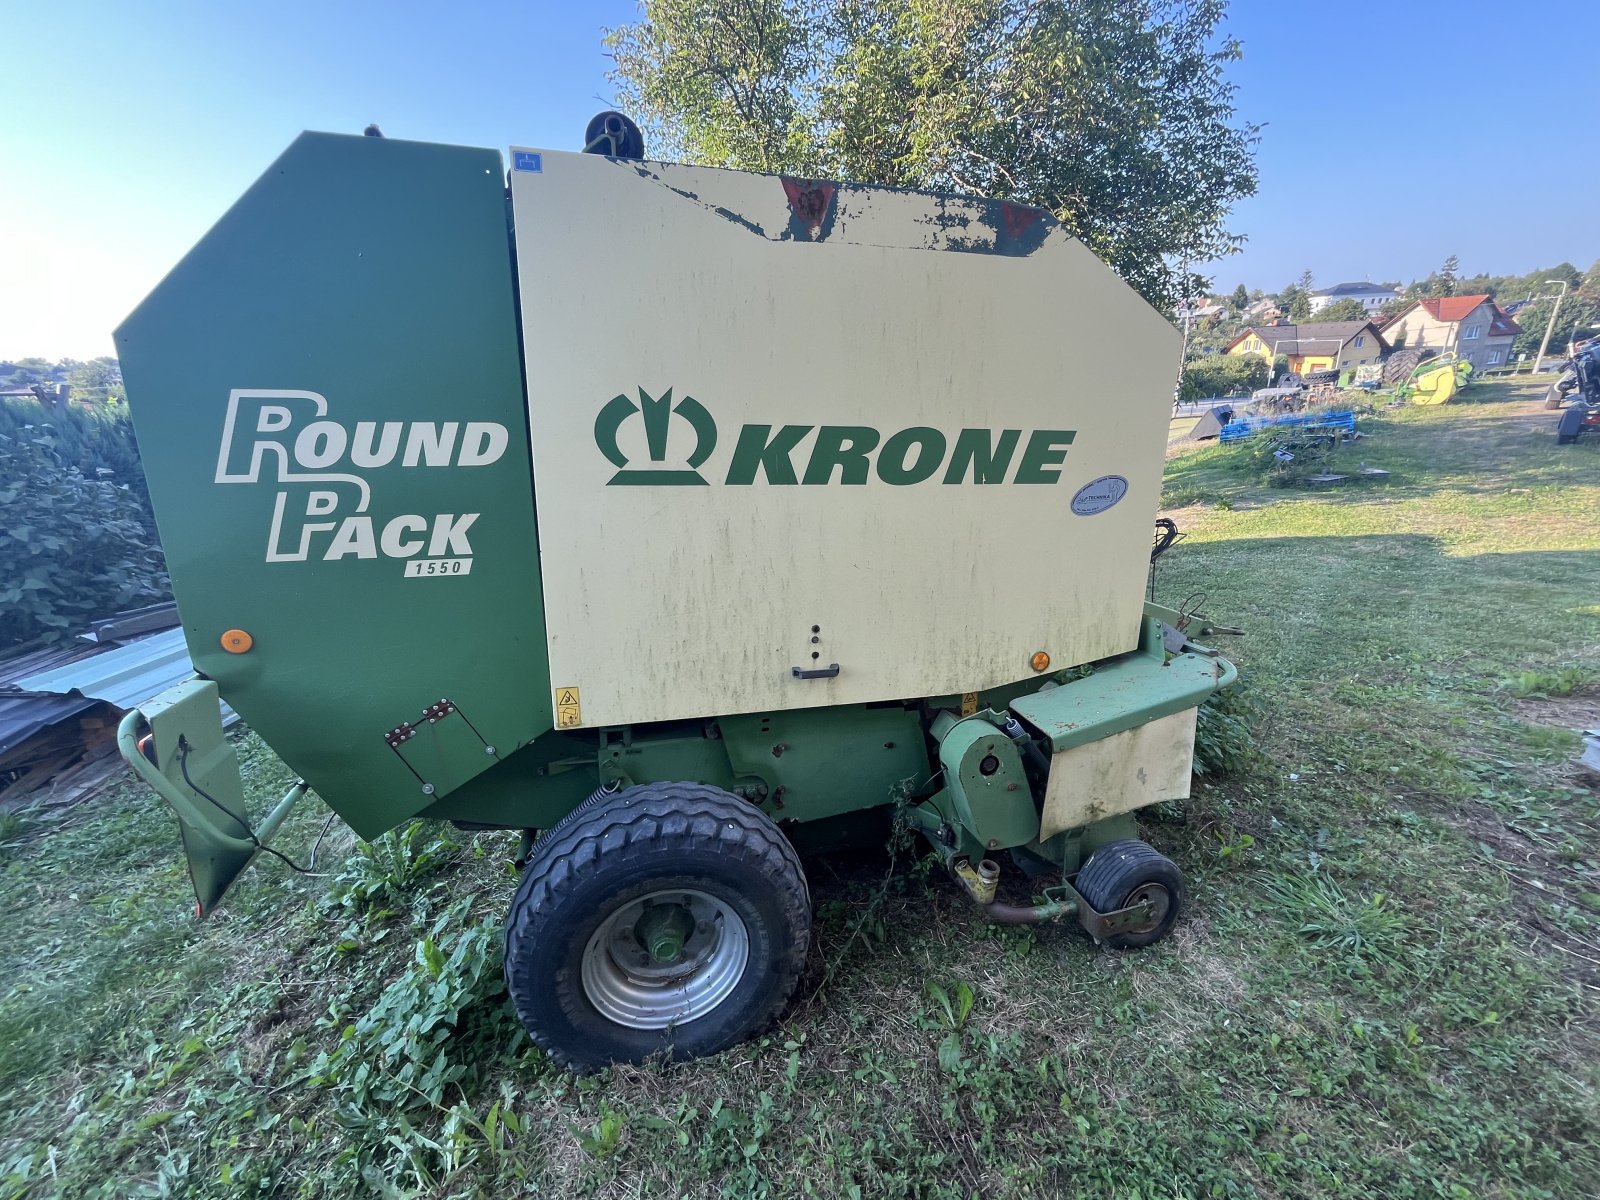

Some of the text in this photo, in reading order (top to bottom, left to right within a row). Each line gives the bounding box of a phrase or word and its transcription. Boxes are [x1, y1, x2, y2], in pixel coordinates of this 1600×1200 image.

[214, 388, 510, 483] ROUND
[724, 424, 1078, 486] KRONE
[265, 473, 481, 562] PACK
[414, 560, 462, 575] 1550
